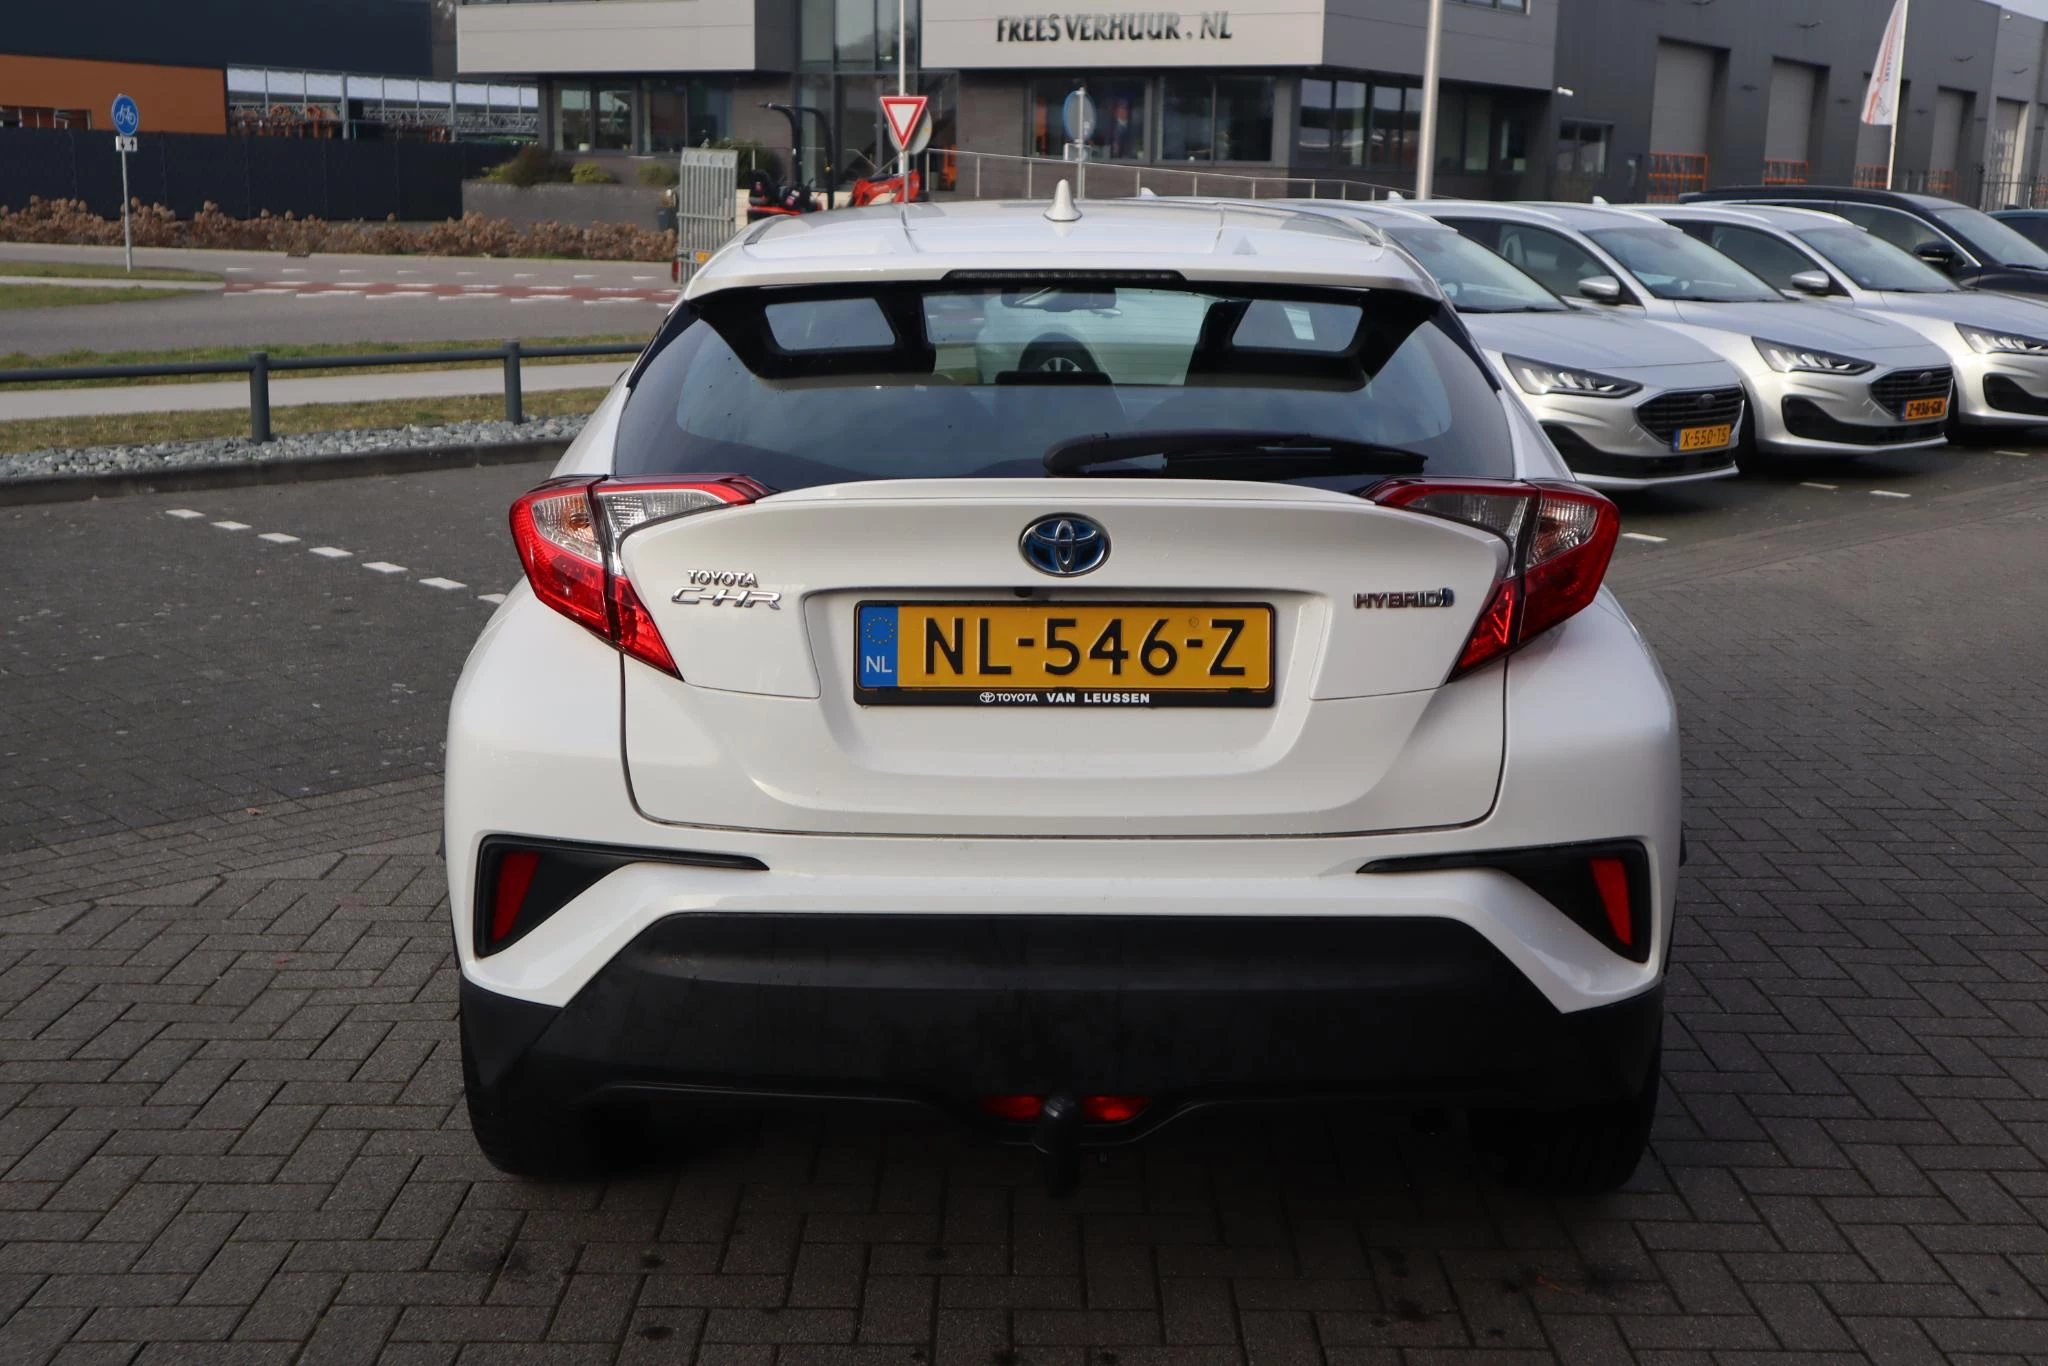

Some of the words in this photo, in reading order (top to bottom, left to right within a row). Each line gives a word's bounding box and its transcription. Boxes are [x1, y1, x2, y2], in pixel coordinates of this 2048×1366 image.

[687, 569, 759, 588] TOYOTA
[671, 586, 781, 610] C-HR
[1354, 591, 1442, 609] HYBRID
[924, 616, 1246, 677] NL-546-Z
[866, 655, 893, 673] NL
[997, 693, 1039, 702] TOYOTA
[1046, 692, 1076, 703] VAN
[1084, 692, 1150, 703] LEUSSEN
